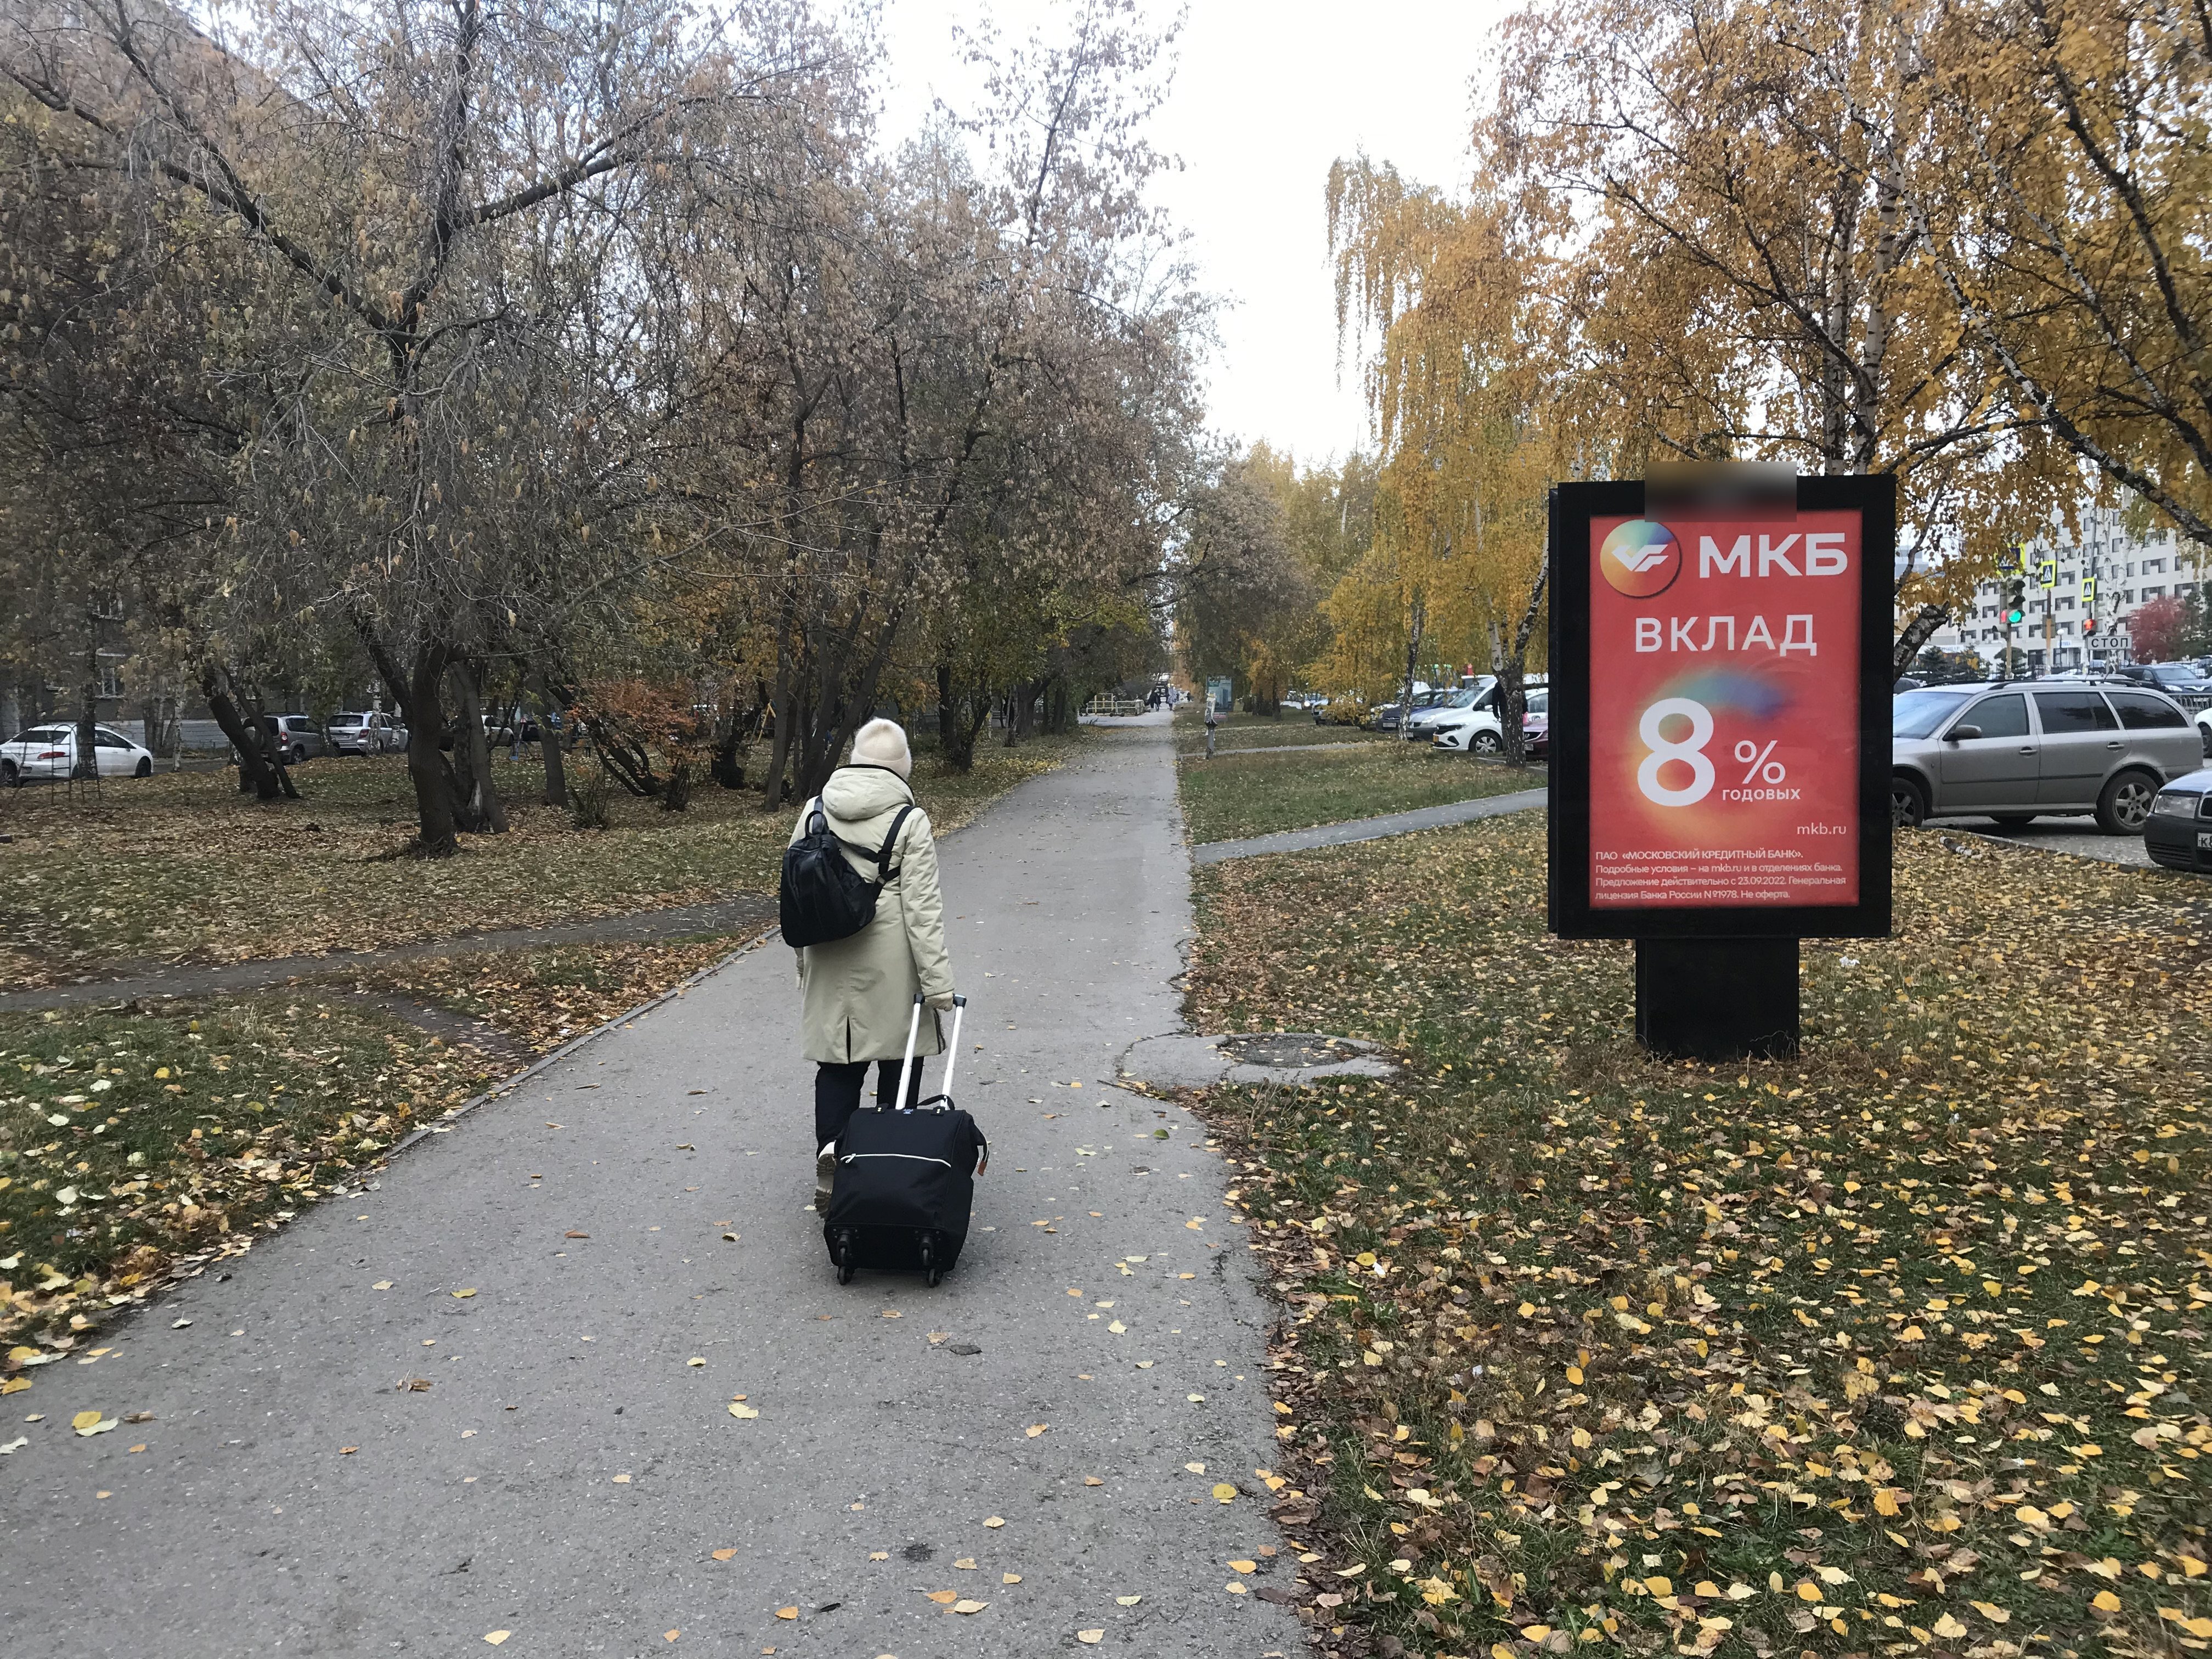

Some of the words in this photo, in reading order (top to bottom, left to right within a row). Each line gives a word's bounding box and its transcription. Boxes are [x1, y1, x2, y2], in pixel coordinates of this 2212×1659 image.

[1700, 532, 1848, 578] МКБ
[1635, 614, 1818, 657] ВКЛАД
[2091, 637, 2128, 648] СТОП
[1797, 822, 1847, 835] mkb.ru
[1595, 851, 1618, 860] ПАО
[1622, 848, 1700, 860] «МОСКОВСКИЙ
[1701, 847, 1766, 860] КРЕДИТНЫЙ
[1767, 849, 1804, 859] БАНК».
[1595, 864, 1650, 875] Подробные
[1651, 866, 1688, 875] условия
[1711, 863, 1742, 872] mkb.ru
[1759, 863, 1812, 873] отделениях
[1814, 862, 1843, 871] банка.
[1595, 878, 1660, 887] Предложение
[1661, 876, 1729, 887] действительно
[1738, 877, 1787, 885] 23.09.2022.
[1788, 876, 1847, 886] Генеральная
[1595, 892, 1639, 900] лицензия
[1640, 890, 1667, 899] Банка
[1669, 890, 1702, 899] России
[1741, 890, 1753, 898] Не
[1755, 889, 1791, 900] оферта.
